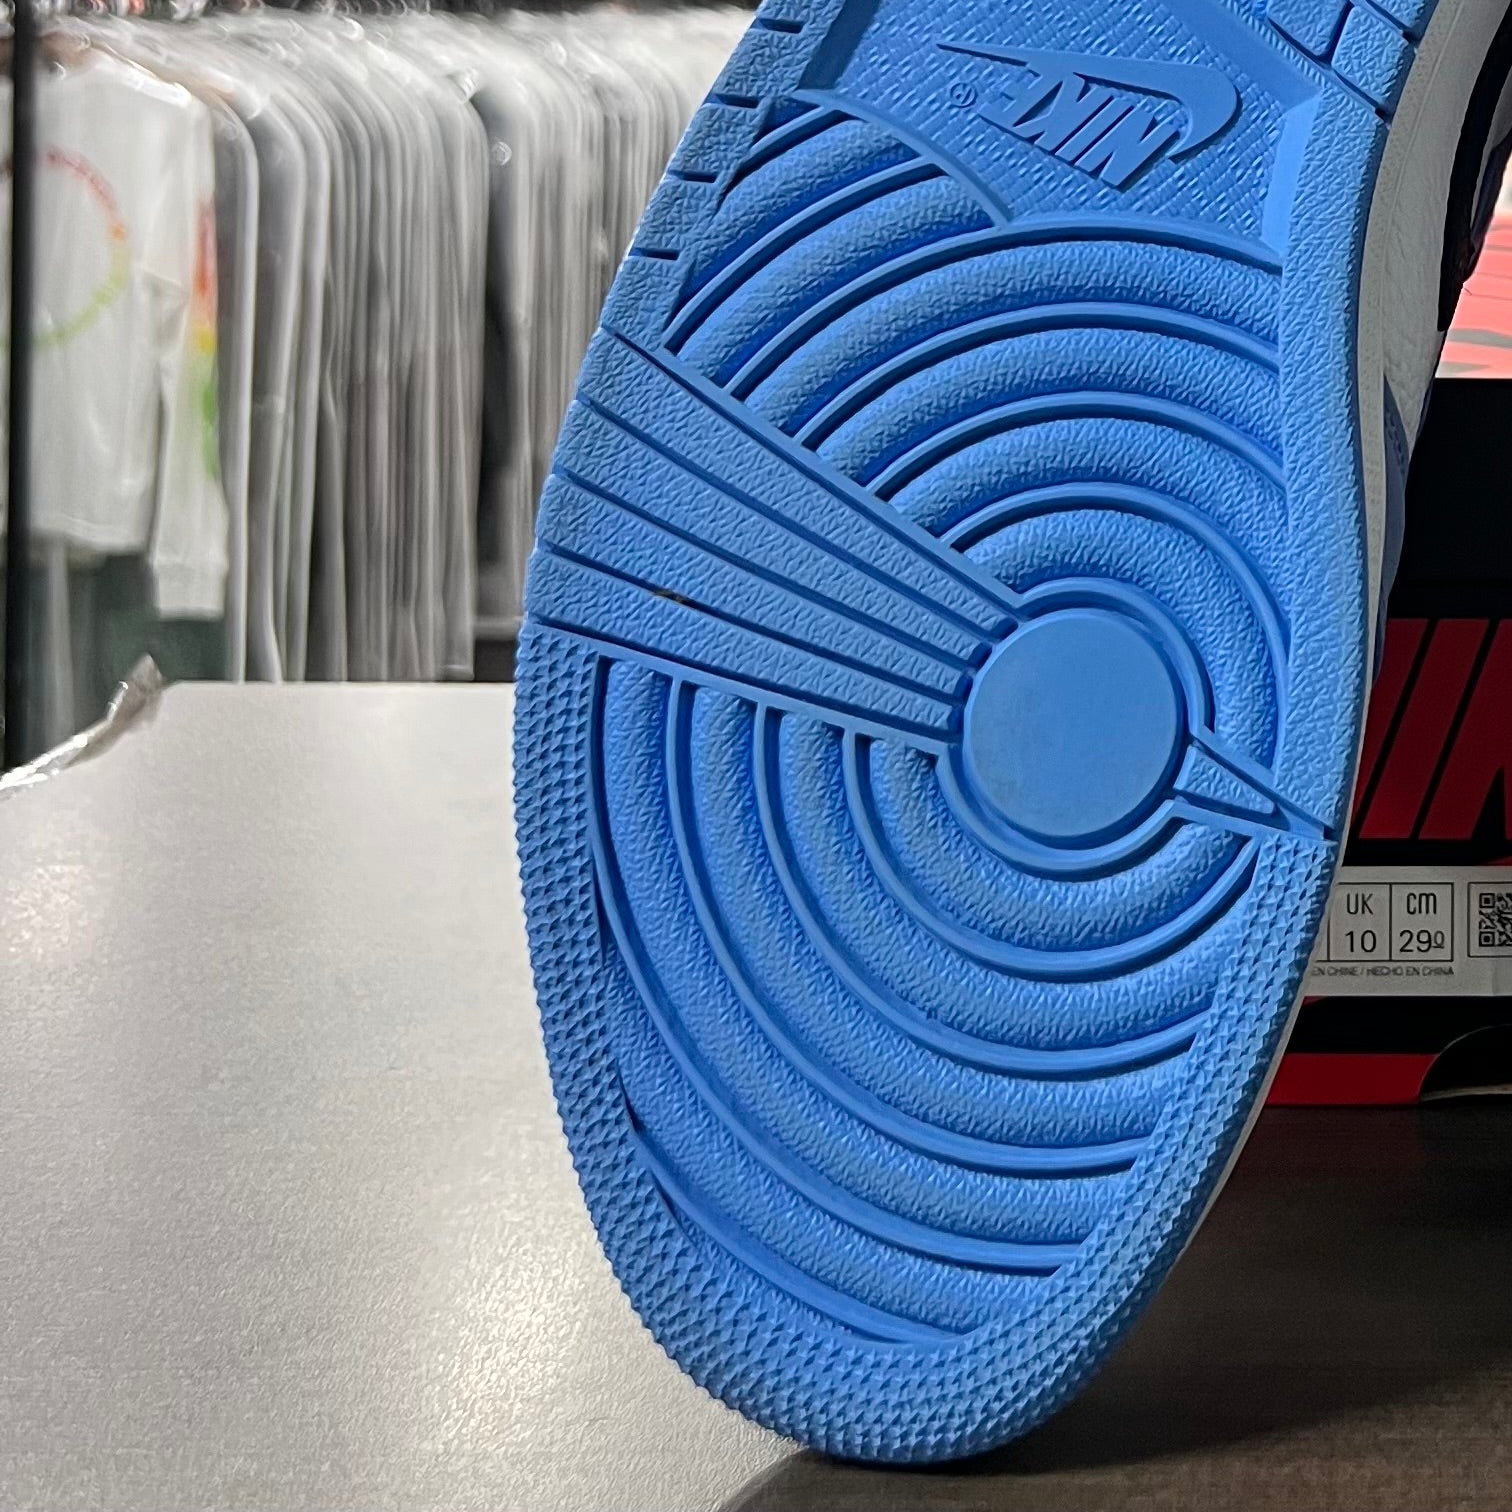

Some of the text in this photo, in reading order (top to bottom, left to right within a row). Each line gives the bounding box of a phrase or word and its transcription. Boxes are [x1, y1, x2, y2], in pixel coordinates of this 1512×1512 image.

[976, 66, 1182, 190] NIKE
[1346, 892, 1374, 916] UK
[1345, 929, 1377, 954] 10
[1406, 966, 1420, 976] EN
[1422, 966, 1454, 976] CHINA
